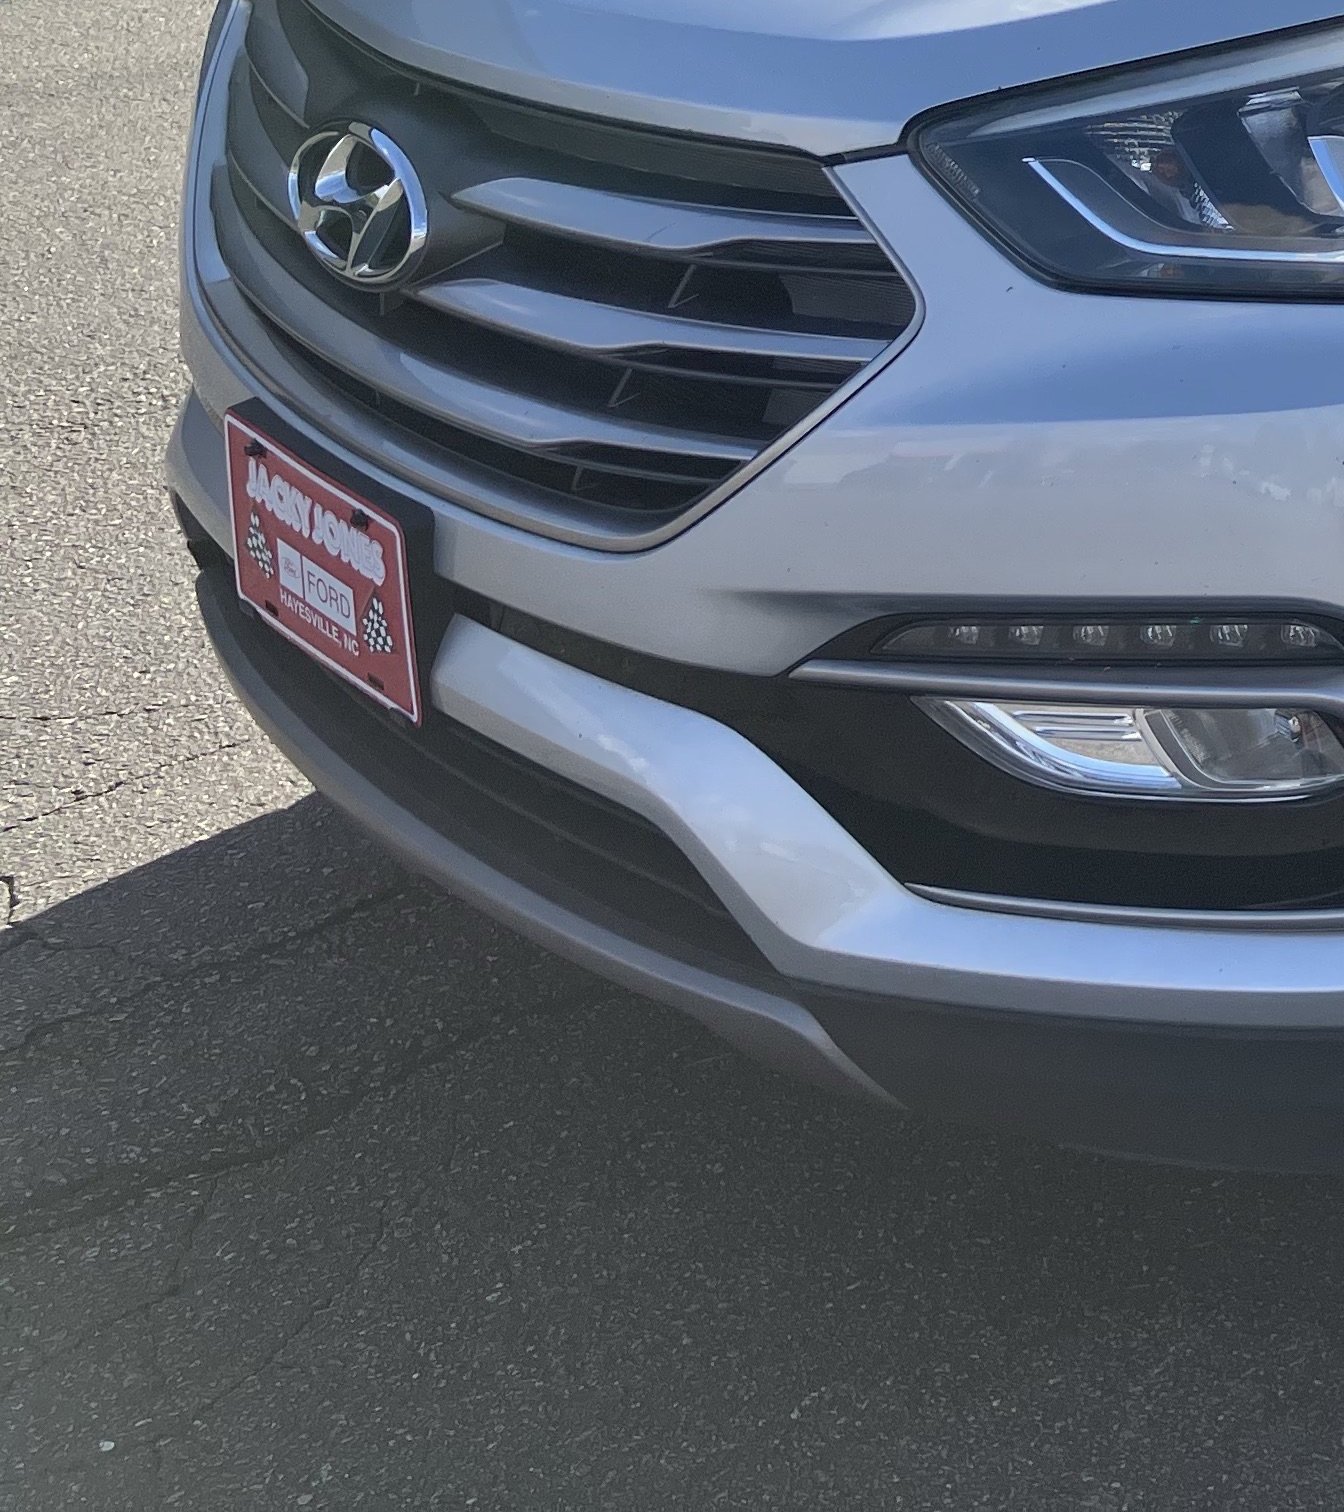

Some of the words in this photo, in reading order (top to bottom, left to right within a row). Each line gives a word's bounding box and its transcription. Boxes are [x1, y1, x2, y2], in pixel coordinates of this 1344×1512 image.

[246, 456, 312, 538] JACKY
[312, 503, 386, 586] JONES
[280, 588, 342, 647] HAYESVILLE,
[343, 632, 359, 657] NC
[307, 570, 351, 619] FORD
